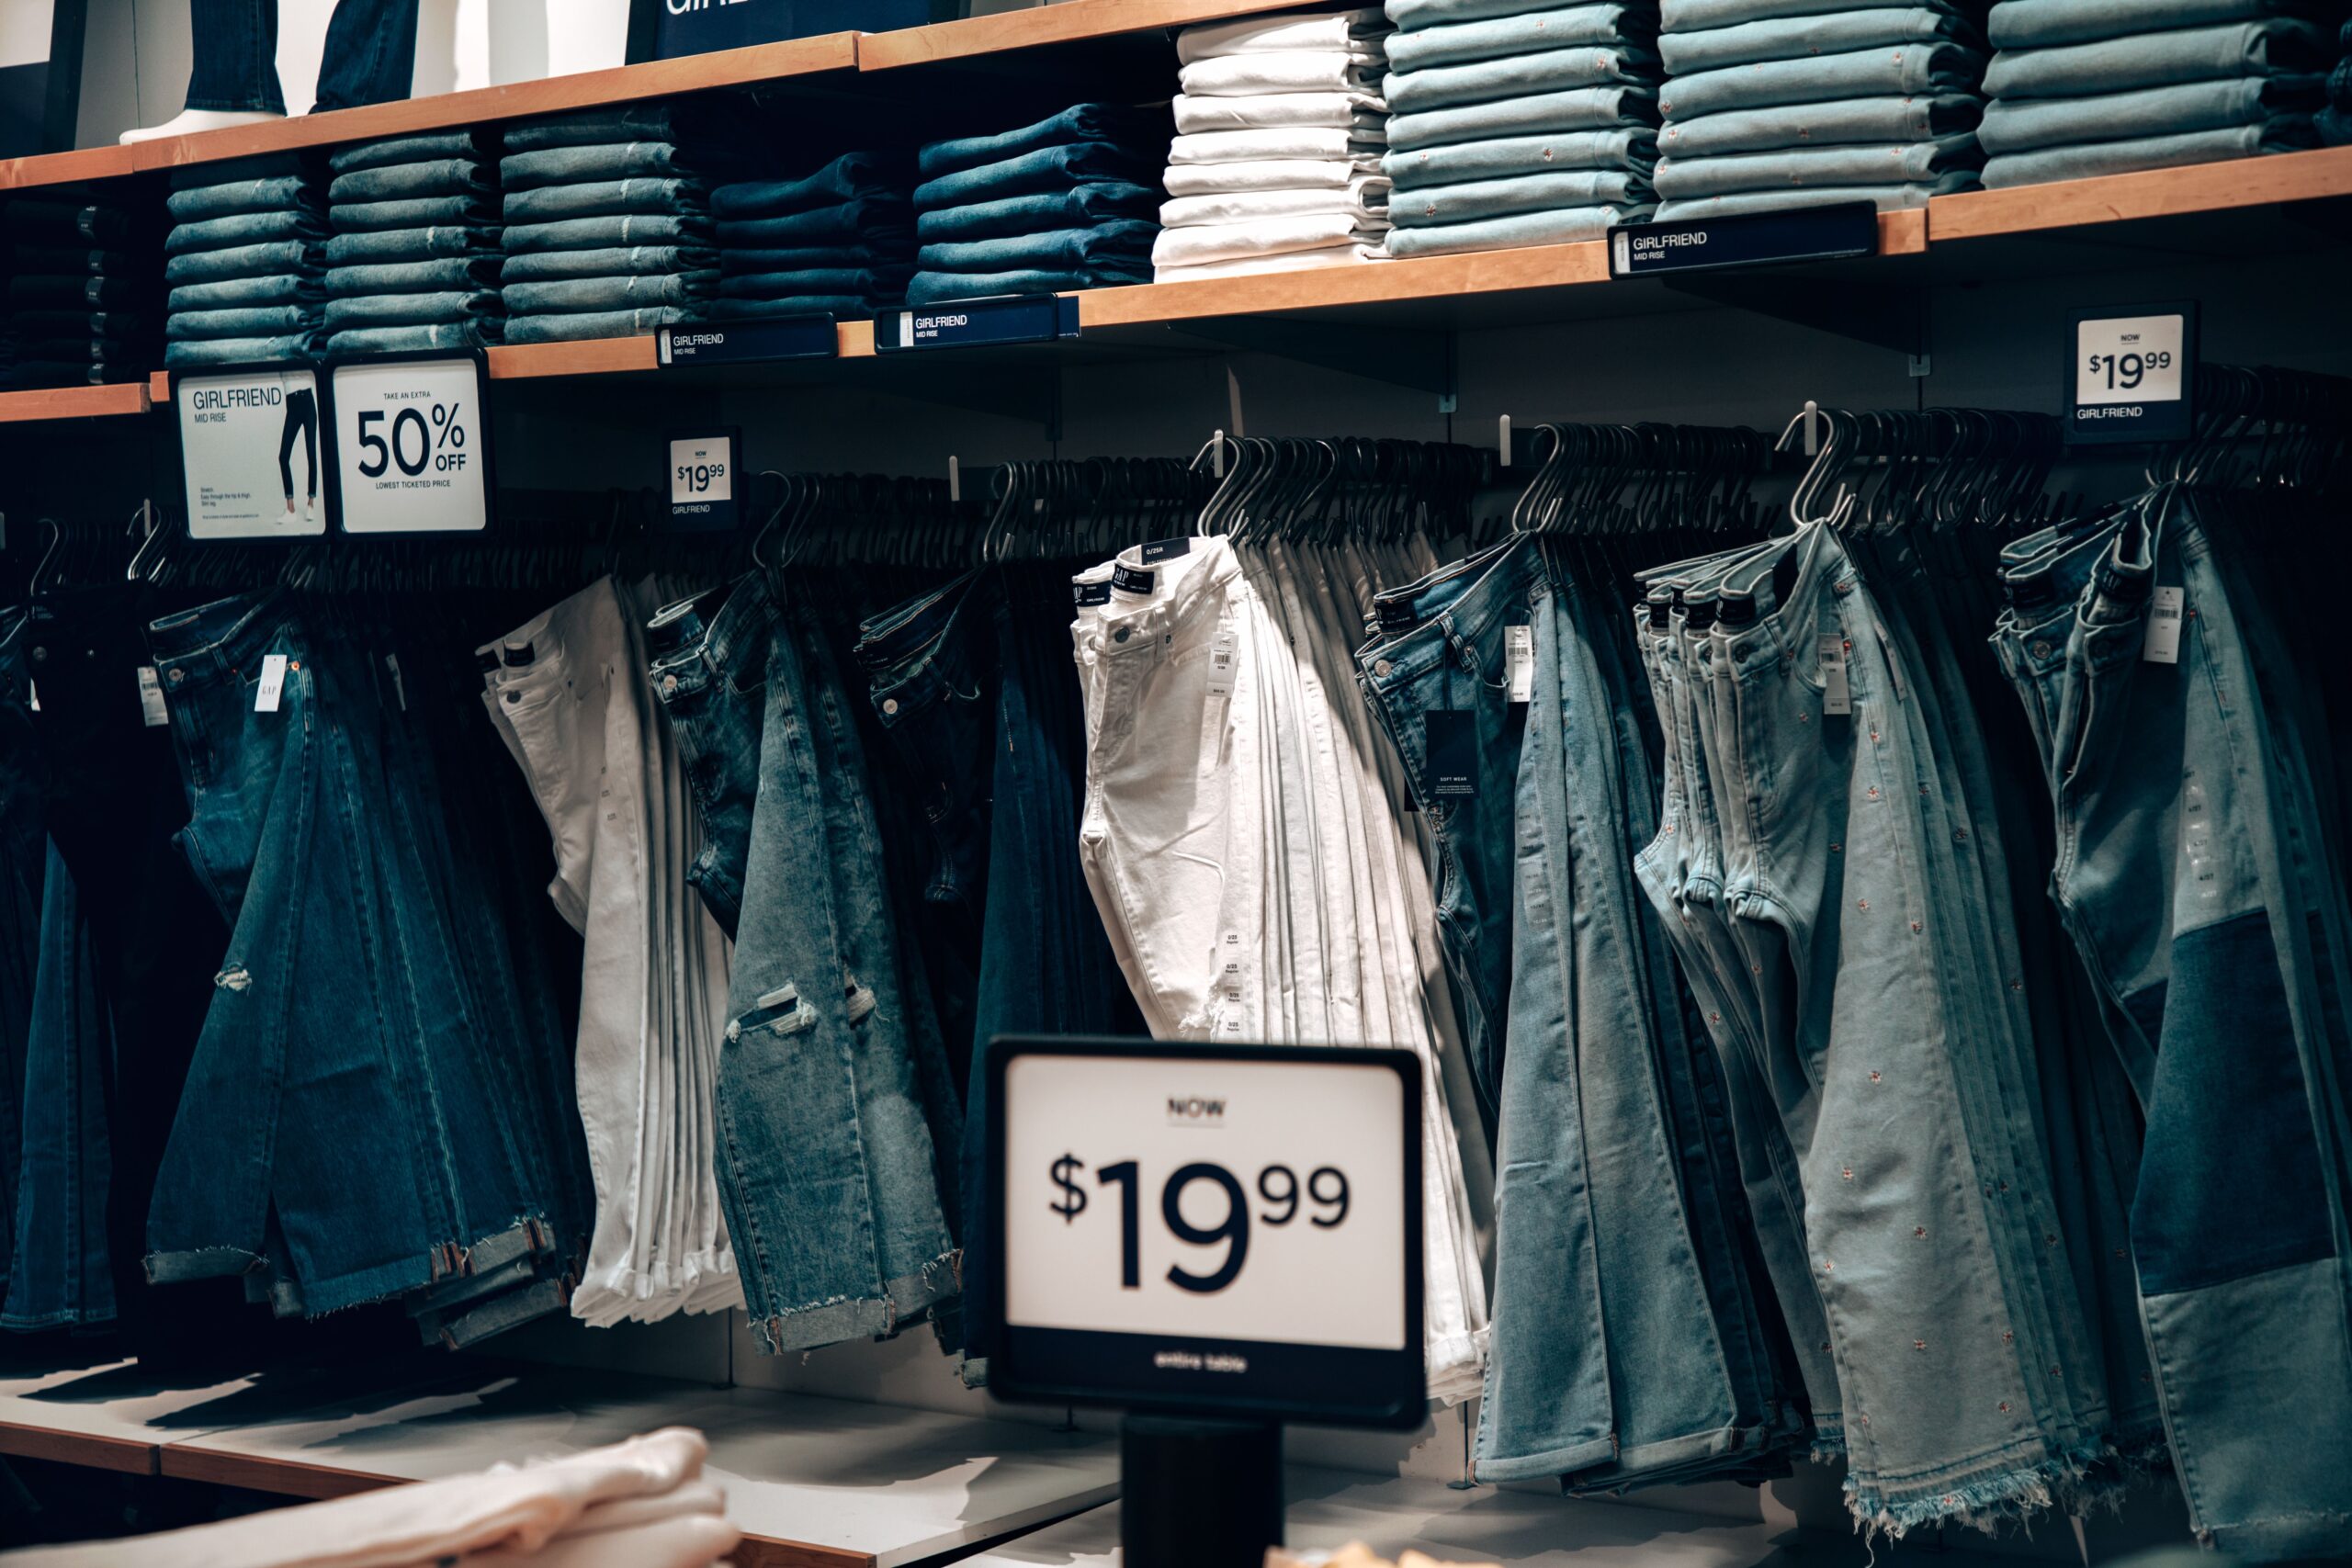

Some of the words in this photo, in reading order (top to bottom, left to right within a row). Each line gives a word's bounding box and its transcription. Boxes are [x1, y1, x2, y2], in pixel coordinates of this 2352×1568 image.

[1633, 231, 1707, 251] GIRLFRIEND
[1634, 253, 1647, 261] MID
[1649, 251, 1665, 260] RISE
[915, 314, 967, 329] GIRLFRIEND
[673, 333, 724, 346] GIRLFRIEND
[2120, 333, 2140, 342] NOW
[193, 387, 282, 410] GIRLFRIEND
[411, 390, 431, 399] EXTRA
[194, 413, 209, 423] MID
[209, 412, 227, 423] RISE
[2077, 406, 2143, 420] GIRLFRIEND
[358, 402, 465, 478] 50%
[435, 454, 467, 471] OFF
[376, 481, 400, 490] LOWEST
[401, 480, 431, 489] TICKETED
[433, 479, 451, 488] PRICE
[673, 504, 710, 514] GIRLFRIEND
[262, 685, 277, 695] GAP
[1167, 1097, 1227, 1118] NOW
[1154, 1351, 1202, 1370] entire
[1204, 1353, 1248, 1373] table
